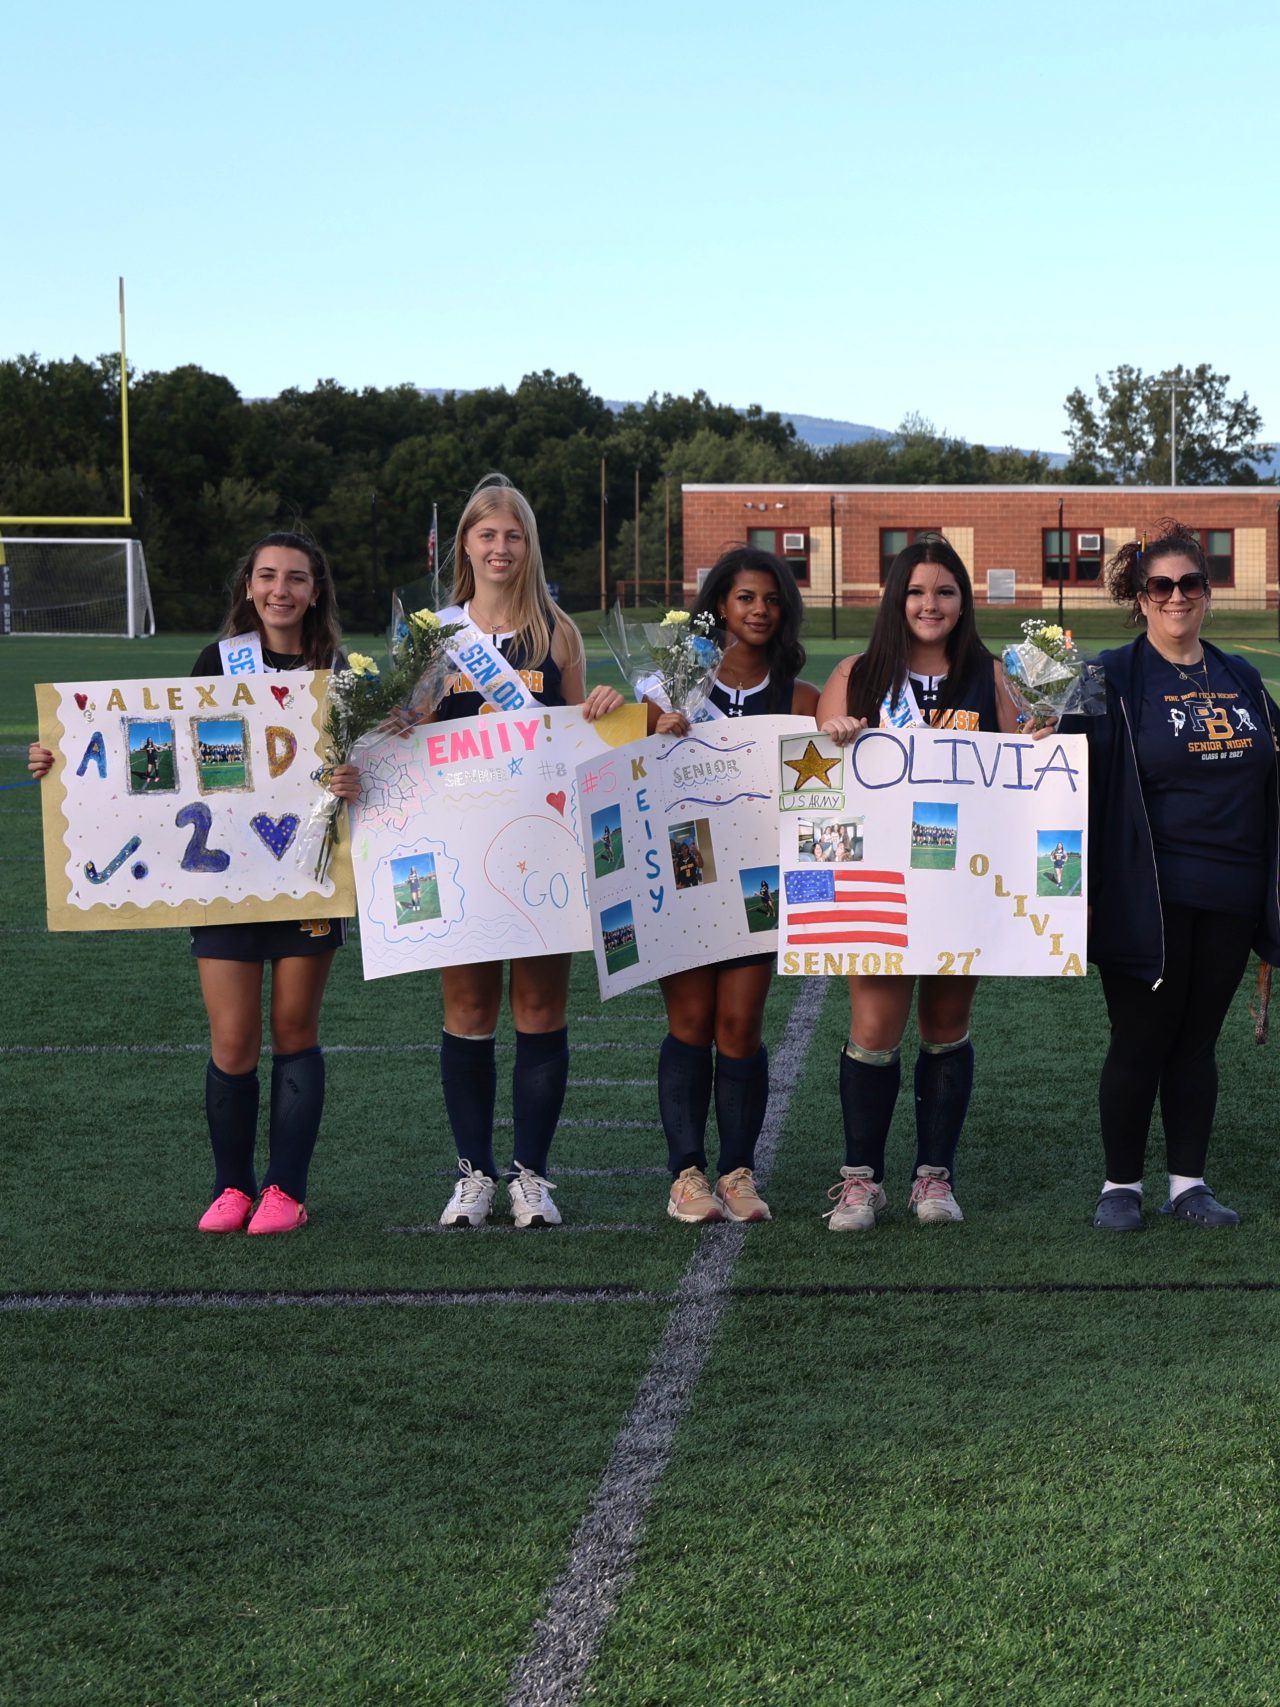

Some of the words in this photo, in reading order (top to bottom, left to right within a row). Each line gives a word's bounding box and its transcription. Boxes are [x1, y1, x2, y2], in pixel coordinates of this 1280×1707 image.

[106, 682, 256, 712] ALEXA
[1188, 741, 1223, 752] SENIOR
[1225, 738, 1253, 750] NIGHT
[1201, 753, 1219, 761] CLASS
[582, 761, 617, 793] #5
[673, 759, 739, 783] SENIOR
[852, 732, 1079, 792] OLIVIA
[175, 801, 231, 873] 2
[969, 854, 1084, 976] OLIVIA
[783, 951, 904, 975] SENIOR
